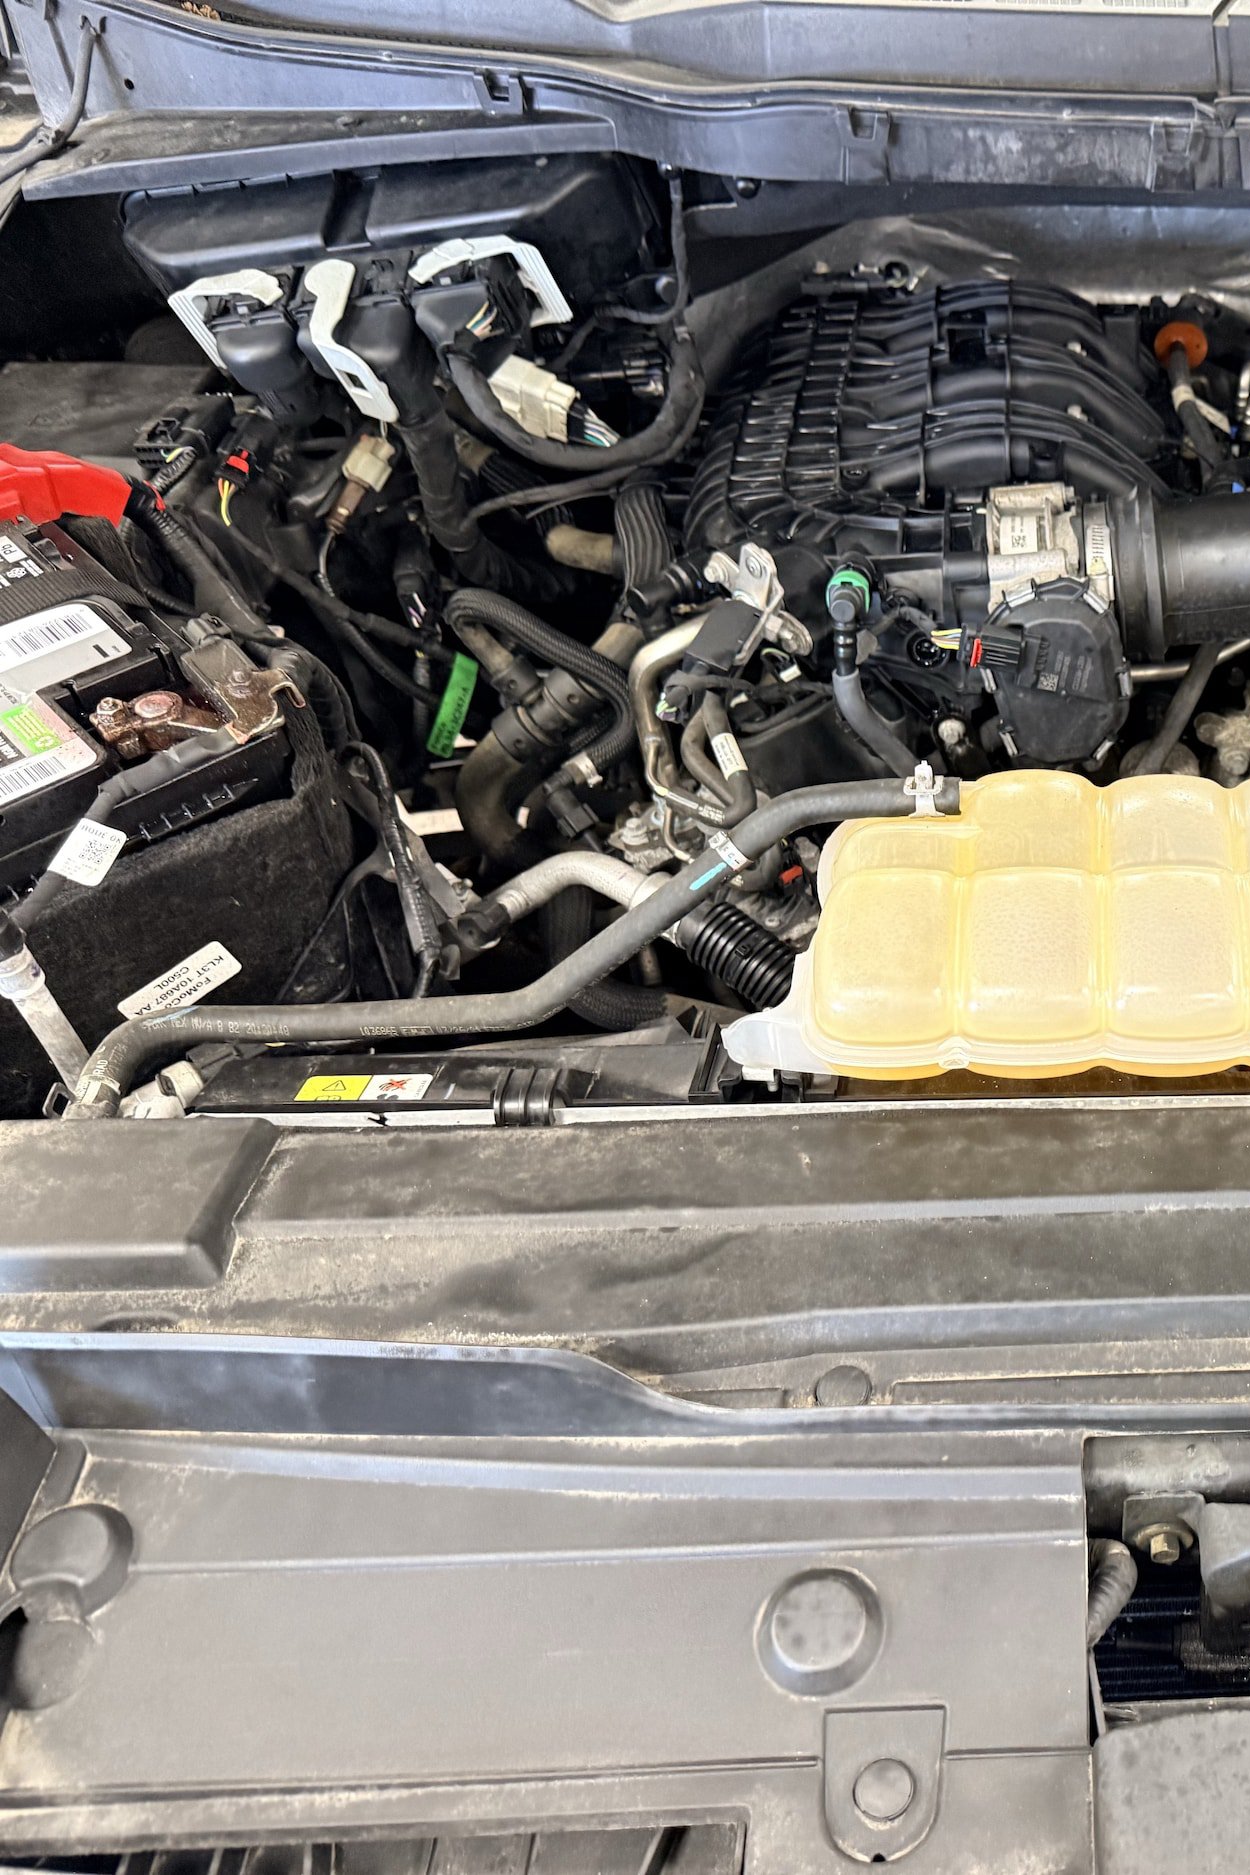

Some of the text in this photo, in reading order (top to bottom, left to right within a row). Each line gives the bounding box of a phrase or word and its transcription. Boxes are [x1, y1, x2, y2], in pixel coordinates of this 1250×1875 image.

[135, 955, 224, 1016] KL3T 10A687 AA
[153, 966, 189, 990] C500L
[164, 977, 211, 1009] FoMoCo
